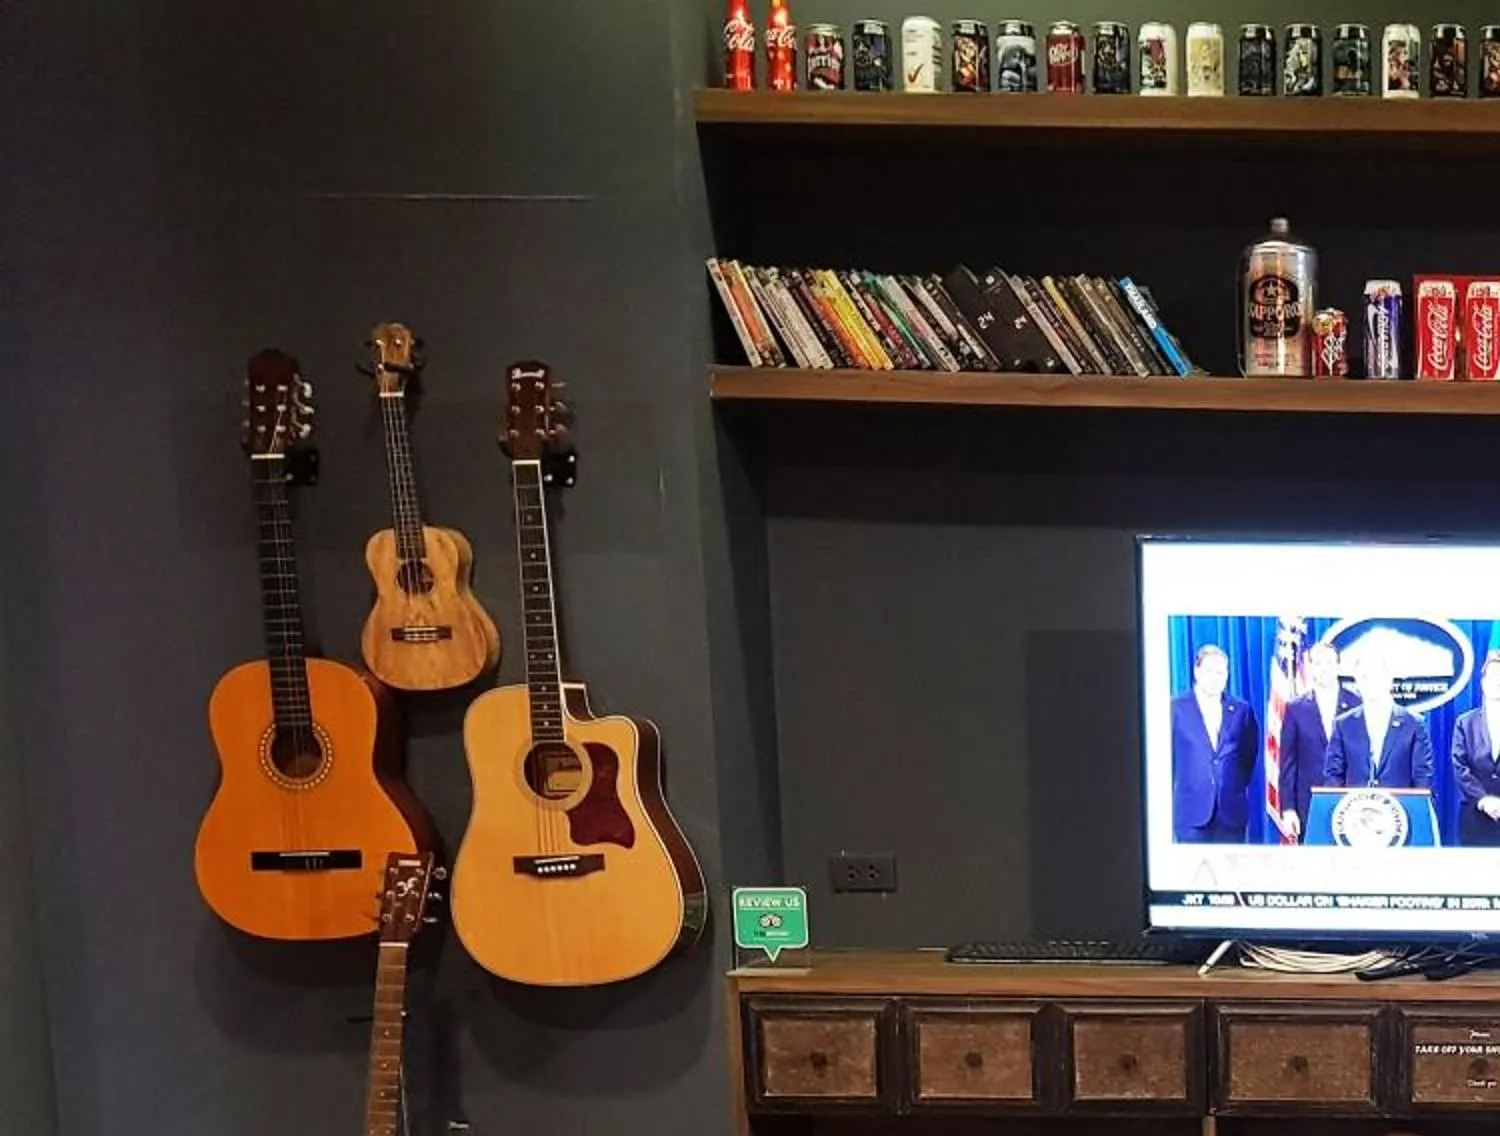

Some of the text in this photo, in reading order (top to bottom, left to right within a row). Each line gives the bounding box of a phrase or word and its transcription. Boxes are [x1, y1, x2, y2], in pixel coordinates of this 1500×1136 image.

[1427, 300, 1449, 371] Coca-Cola
[1472, 299, 1493, 371] Coca-Cola
[1266, 895, 1312, 908] DOLLAR
[1415, 1045, 1439, 1054] TAKE
